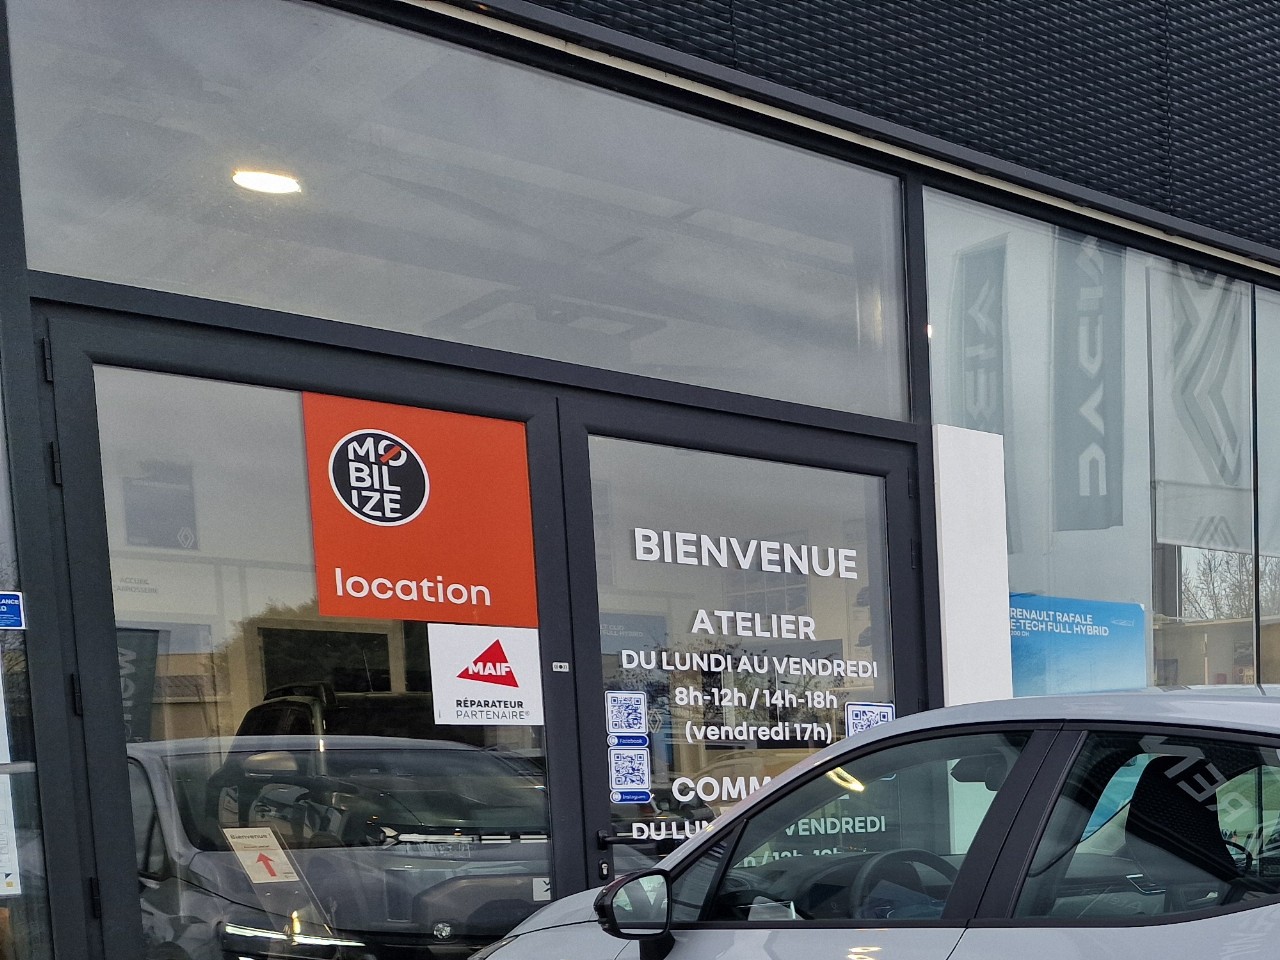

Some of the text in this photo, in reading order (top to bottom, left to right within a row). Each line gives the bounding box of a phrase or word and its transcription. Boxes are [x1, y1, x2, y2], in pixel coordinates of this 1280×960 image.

[633, 527, 859, 580] BIENVENUE
[334, 567, 491, 606] location
[691, 609, 817, 640] ATELIER
[1010, 607, 1093, 625] RENAULT RAFALE
[1010, 619, 1110, 636] E-TECH FULL HYBRID
[468, 661, 512, 676] MAIF
[621, 649, 878, 679] DU LUNDI AU VENDREDI
[456, 697, 524, 709] RÉPARATEUR
[674, 686, 747, 708] 8h-12h
[762, 688, 838, 710] 14h-18h
[685, 719, 833, 745] (vendredi 17h)
[631, 820, 667, 841] DU
